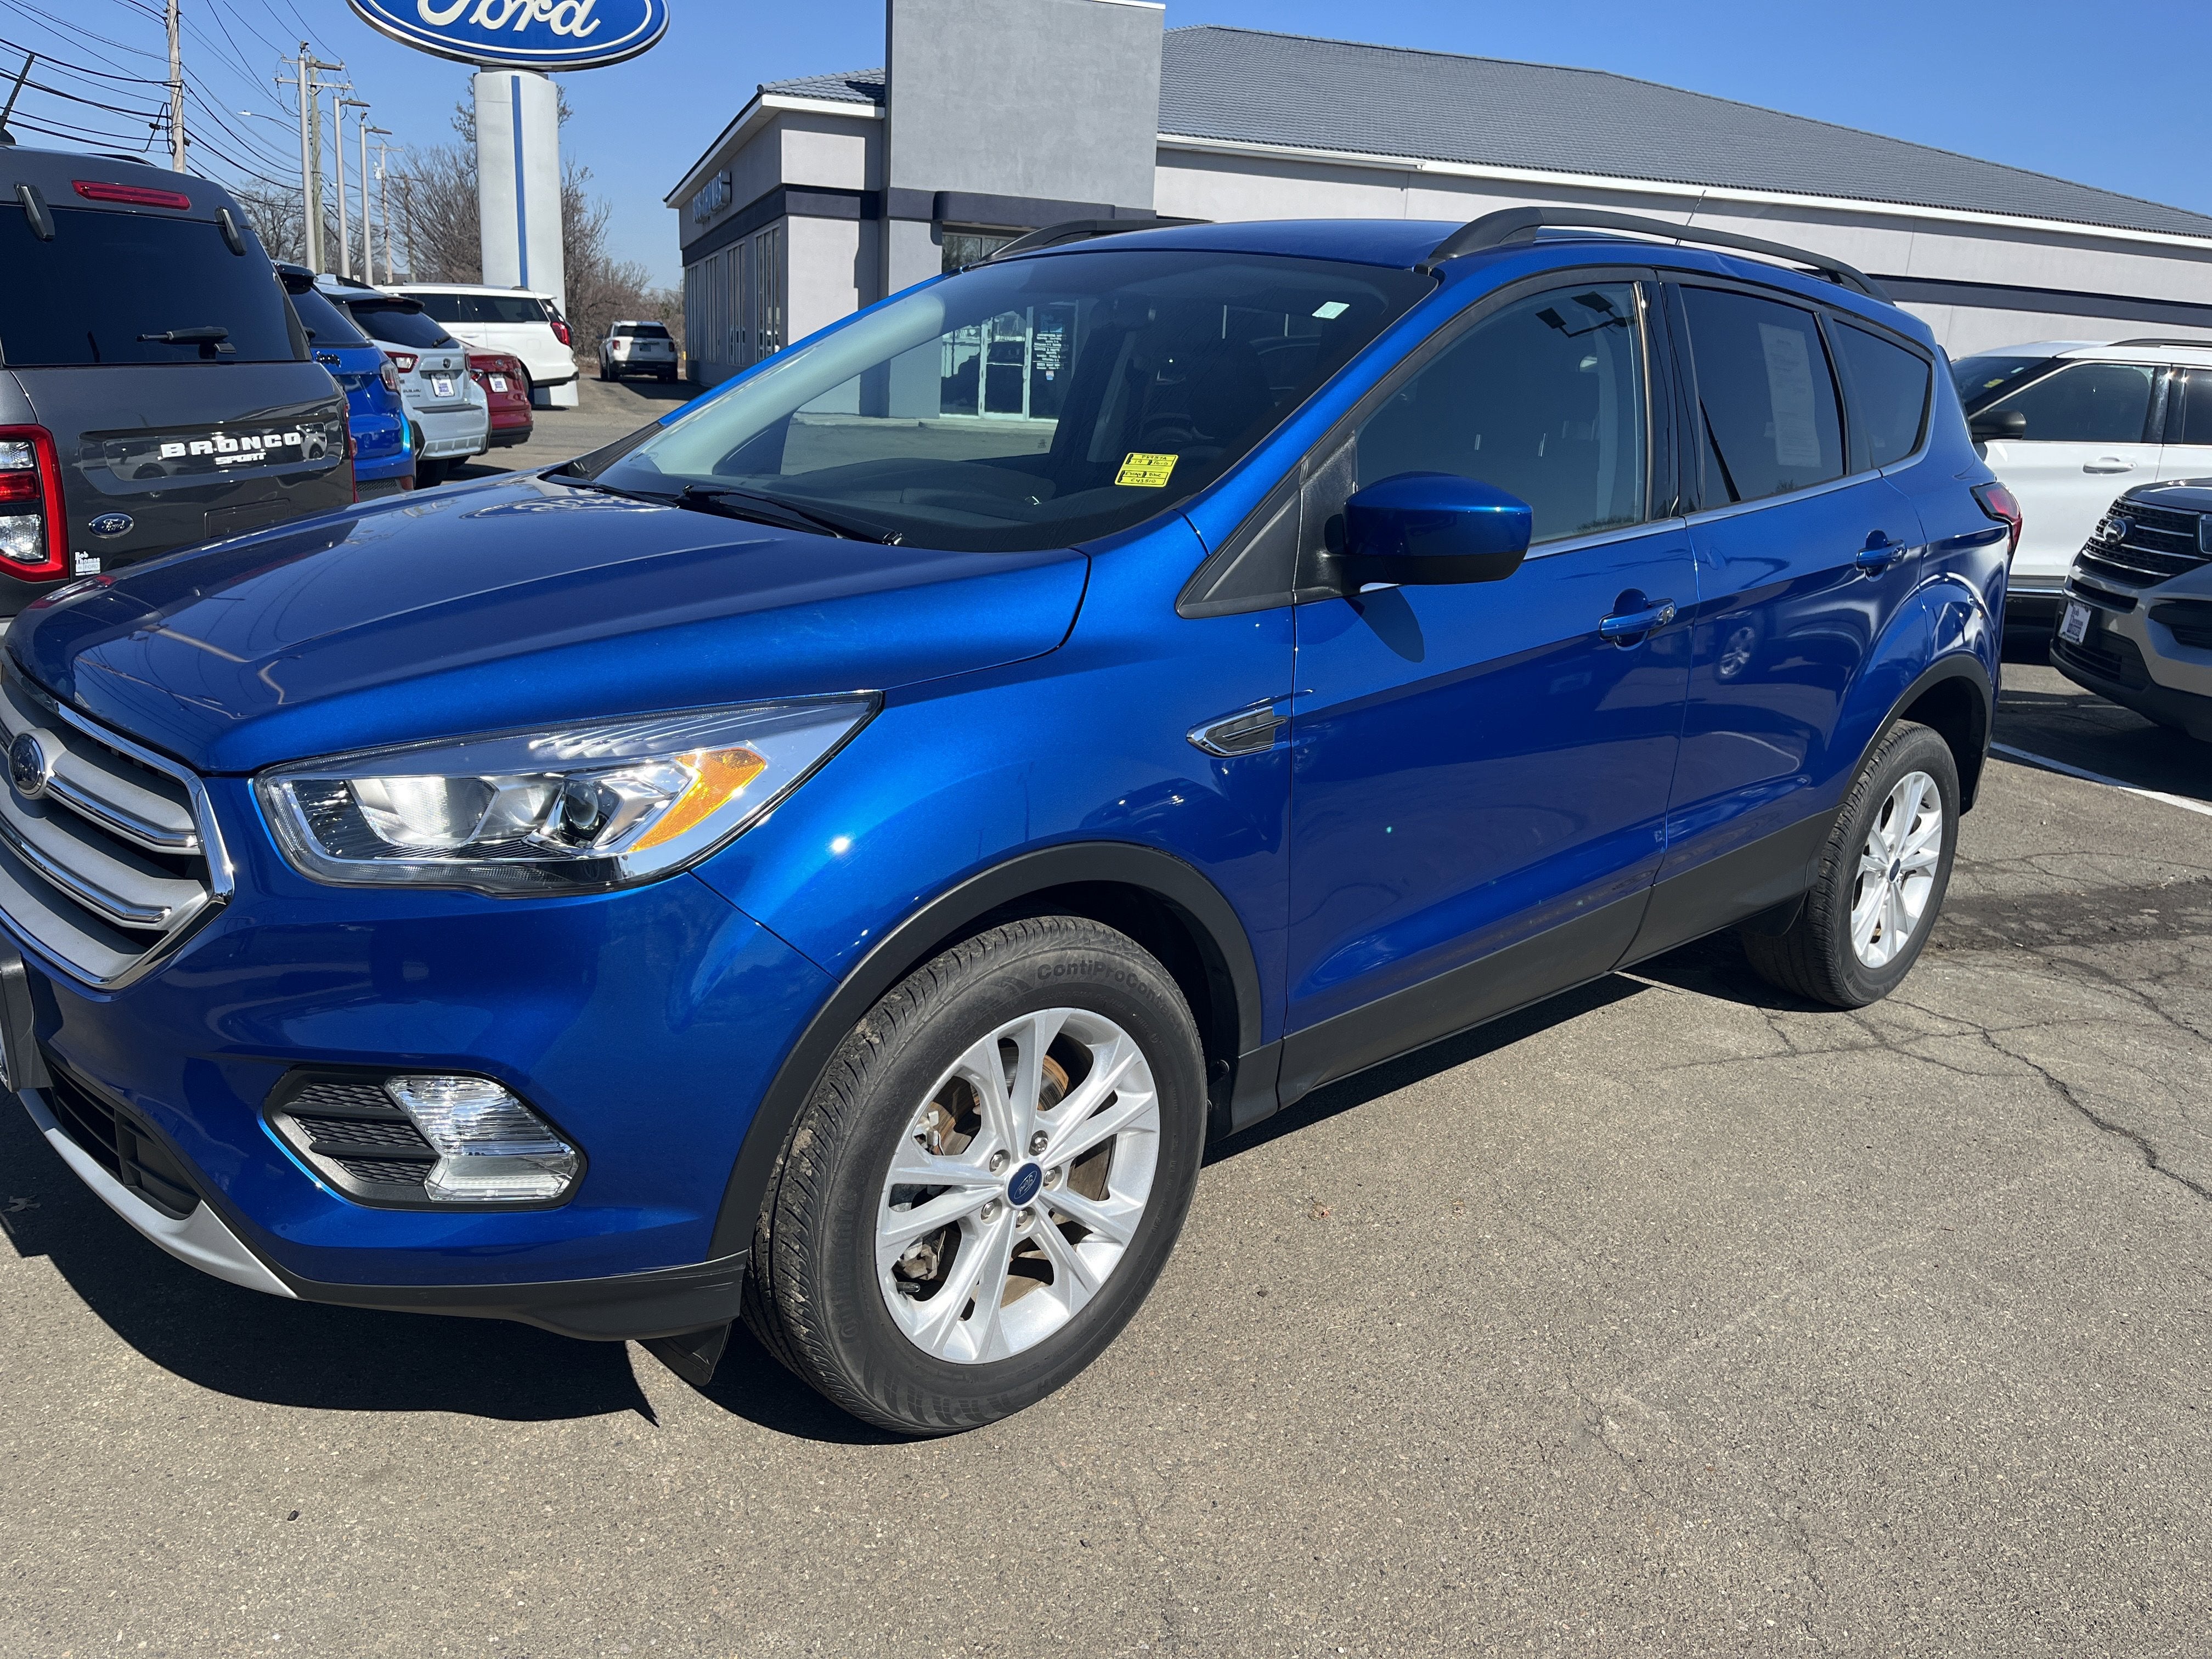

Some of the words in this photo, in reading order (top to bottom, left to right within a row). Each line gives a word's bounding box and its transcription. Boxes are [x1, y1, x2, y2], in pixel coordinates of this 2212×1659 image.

[160, 432, 301, 458] BRONCO
[215, 452, 267, 465] SPORT
[1018, 1174, 1034, 1195] Ford
